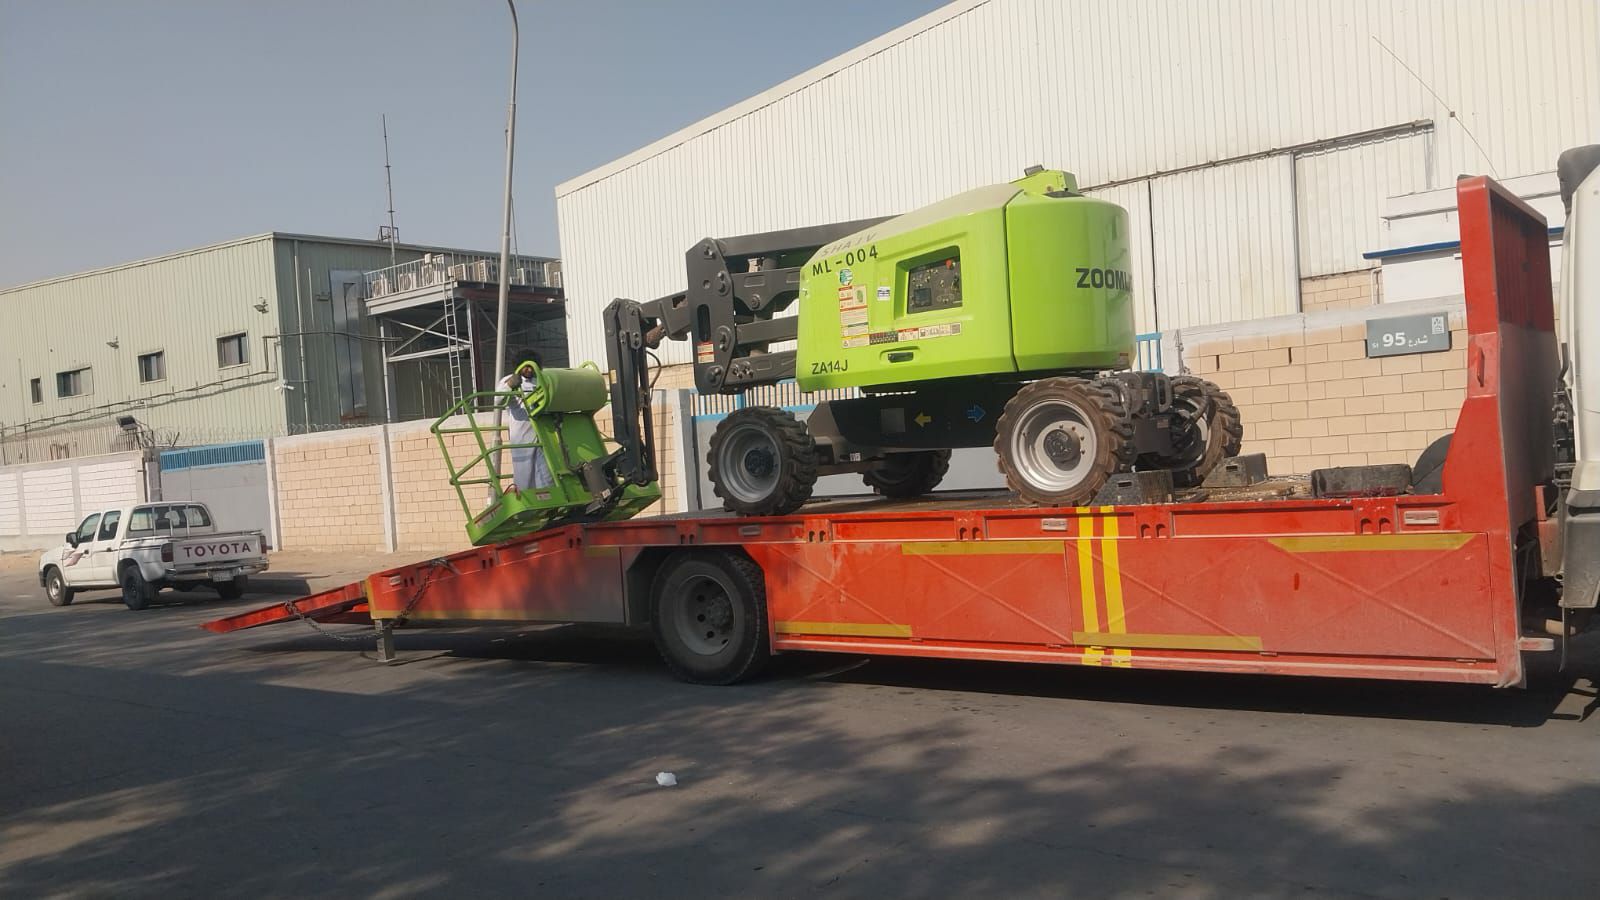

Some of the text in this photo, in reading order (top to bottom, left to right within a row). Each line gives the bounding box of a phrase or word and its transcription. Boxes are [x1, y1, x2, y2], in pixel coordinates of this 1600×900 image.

[812, 245, 878, 276] ML-004
[1075, 267, 1132, 293] ZOOML
[1382, 332, 1406, 347] 95
[1408, 334, 1428, 348] شارع
[811, 359, 849, 375] ZA14J
[183, 542, 251, 558] TOYOTA
